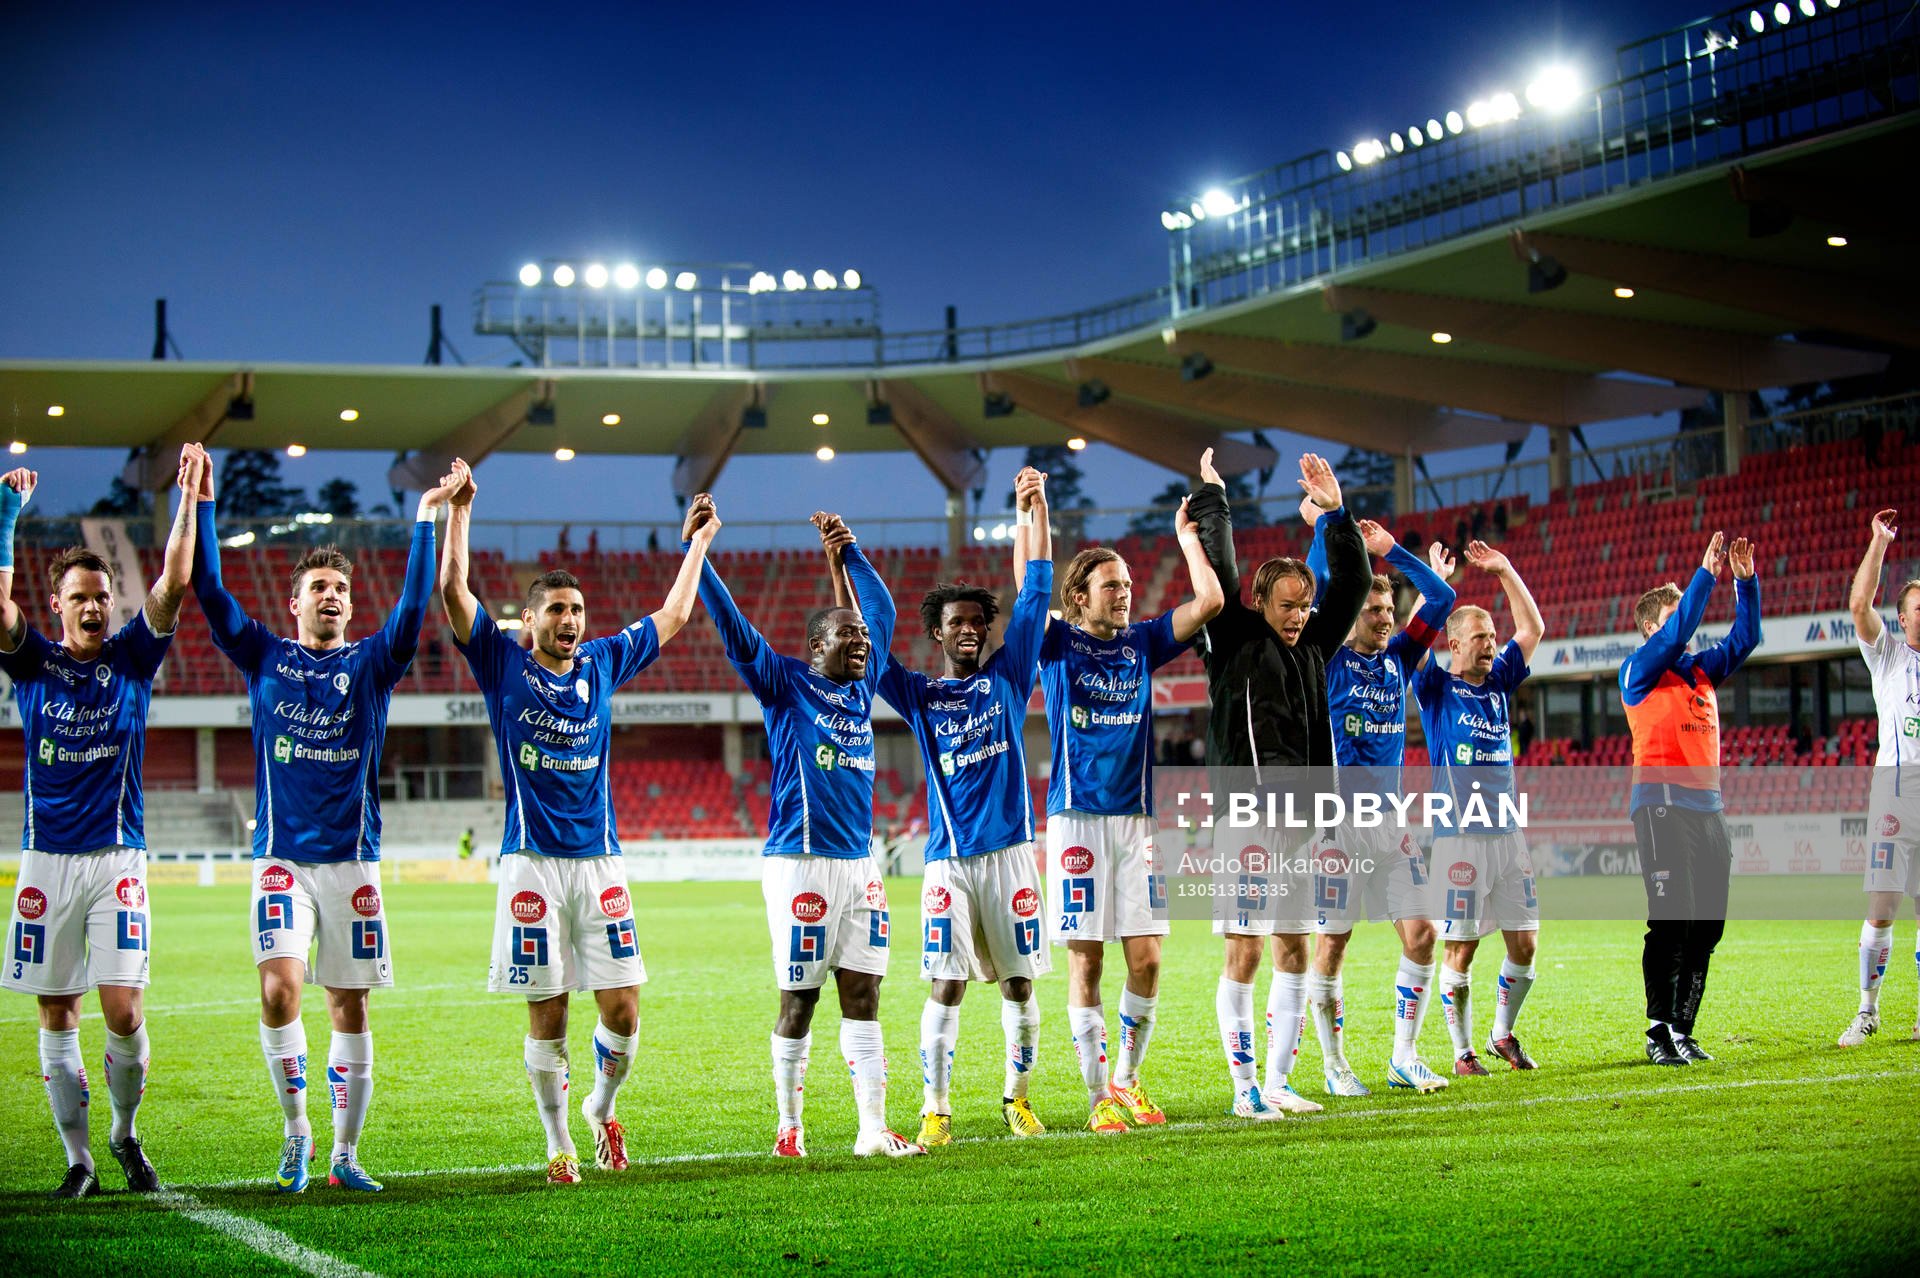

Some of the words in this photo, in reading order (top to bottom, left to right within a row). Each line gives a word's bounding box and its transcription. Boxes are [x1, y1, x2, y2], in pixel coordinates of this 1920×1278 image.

[274, 701, 356, 725] Klädhuset
[518, 708, 598, 733] Klädhuet
[287, 725, 344, 740] FALERUM
[1345, 714, 1362, 736] Gt
[533, 731, 590, 747] FALERUM
[58, 744, 120, 762] Grundtuben
[295, 743, 360, 762] Grundtuben
[520, 743, 538, 771] Gt
[816, 745, 834, 771] Gt
[1457, 744, 1472, 765] Gt
[1065, 853, 1089, 865] mix
[262, 873, 289, 886] mix
[1655, 881, 1665, 896] 2
[20, 895, 43, 910] mix
[356, 893, 380, 907] mix
[515, 899, 542, 913] mix
[604, 895, 628, 911] mix
[796, 899, 822, 913] mix
[1061, 915, 1078, 931] 24
[1237, 911, 1249, 927] 11
[1318, 911, 1326, 925] 5
[1444, 920, 1453, 933] 7
[258, 932, 275, 952] 15
[13, 962, 23, 980] 3
[508, 967, 529, 985] 25
[788, 965, 804, 982] 19
[335, 1084, 348, 1109] INTER
